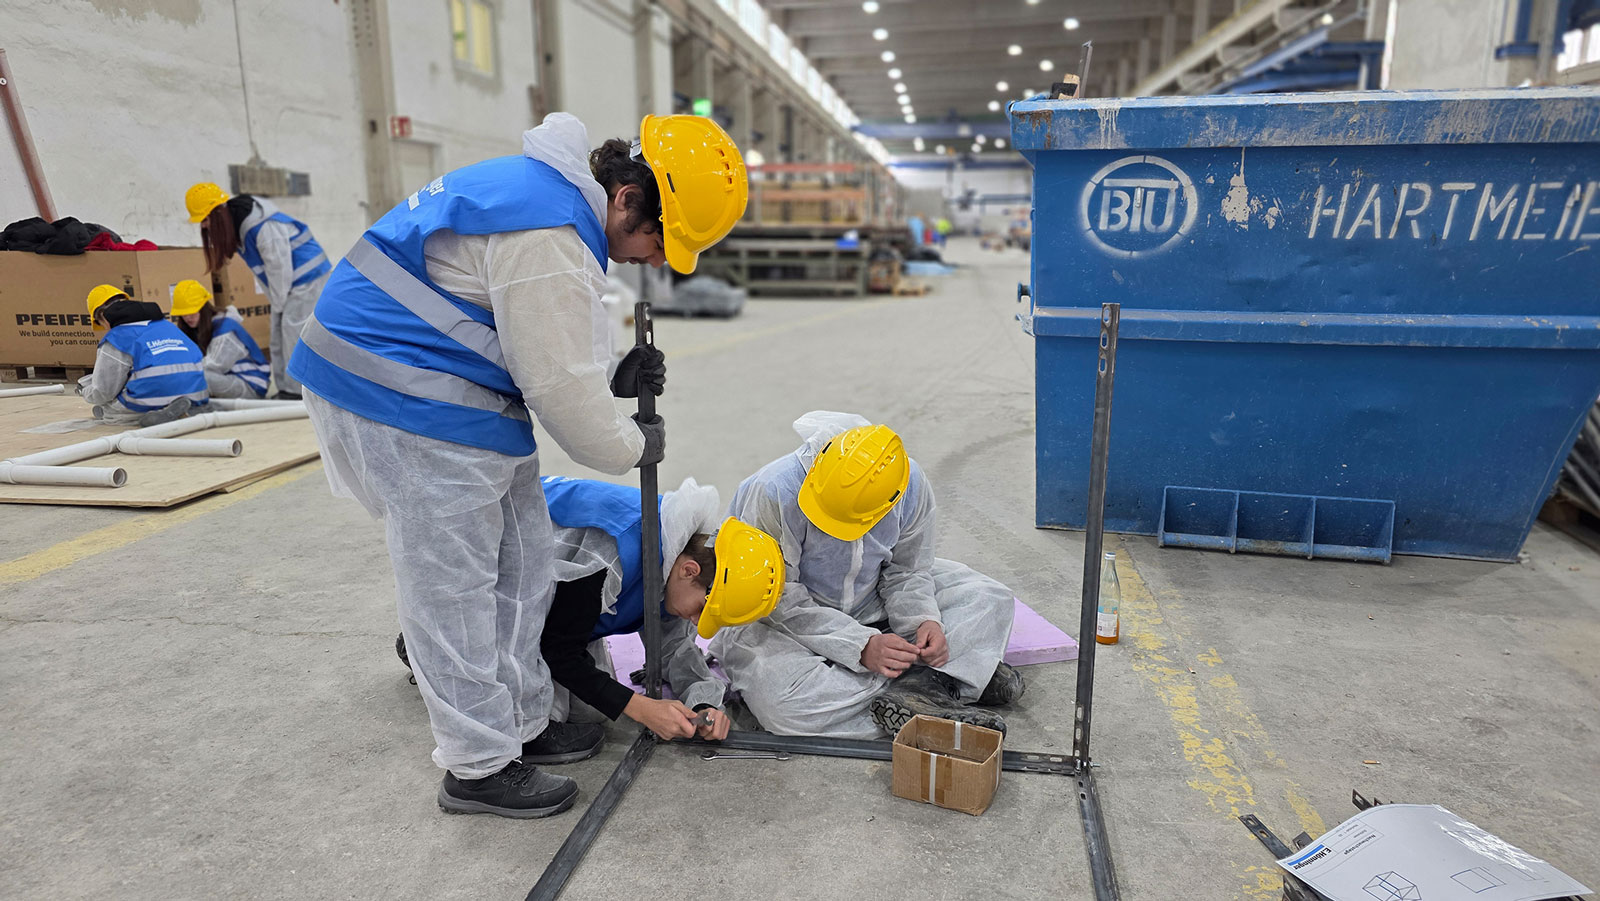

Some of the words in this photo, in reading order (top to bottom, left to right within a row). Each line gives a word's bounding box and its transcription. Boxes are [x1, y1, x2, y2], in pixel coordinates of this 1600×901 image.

[1099, 178, 1179, 233] BTU
[51, 330, 95, 338] connections
[50, 339, 64, 347] you
[79, 338, 100, 346] count
